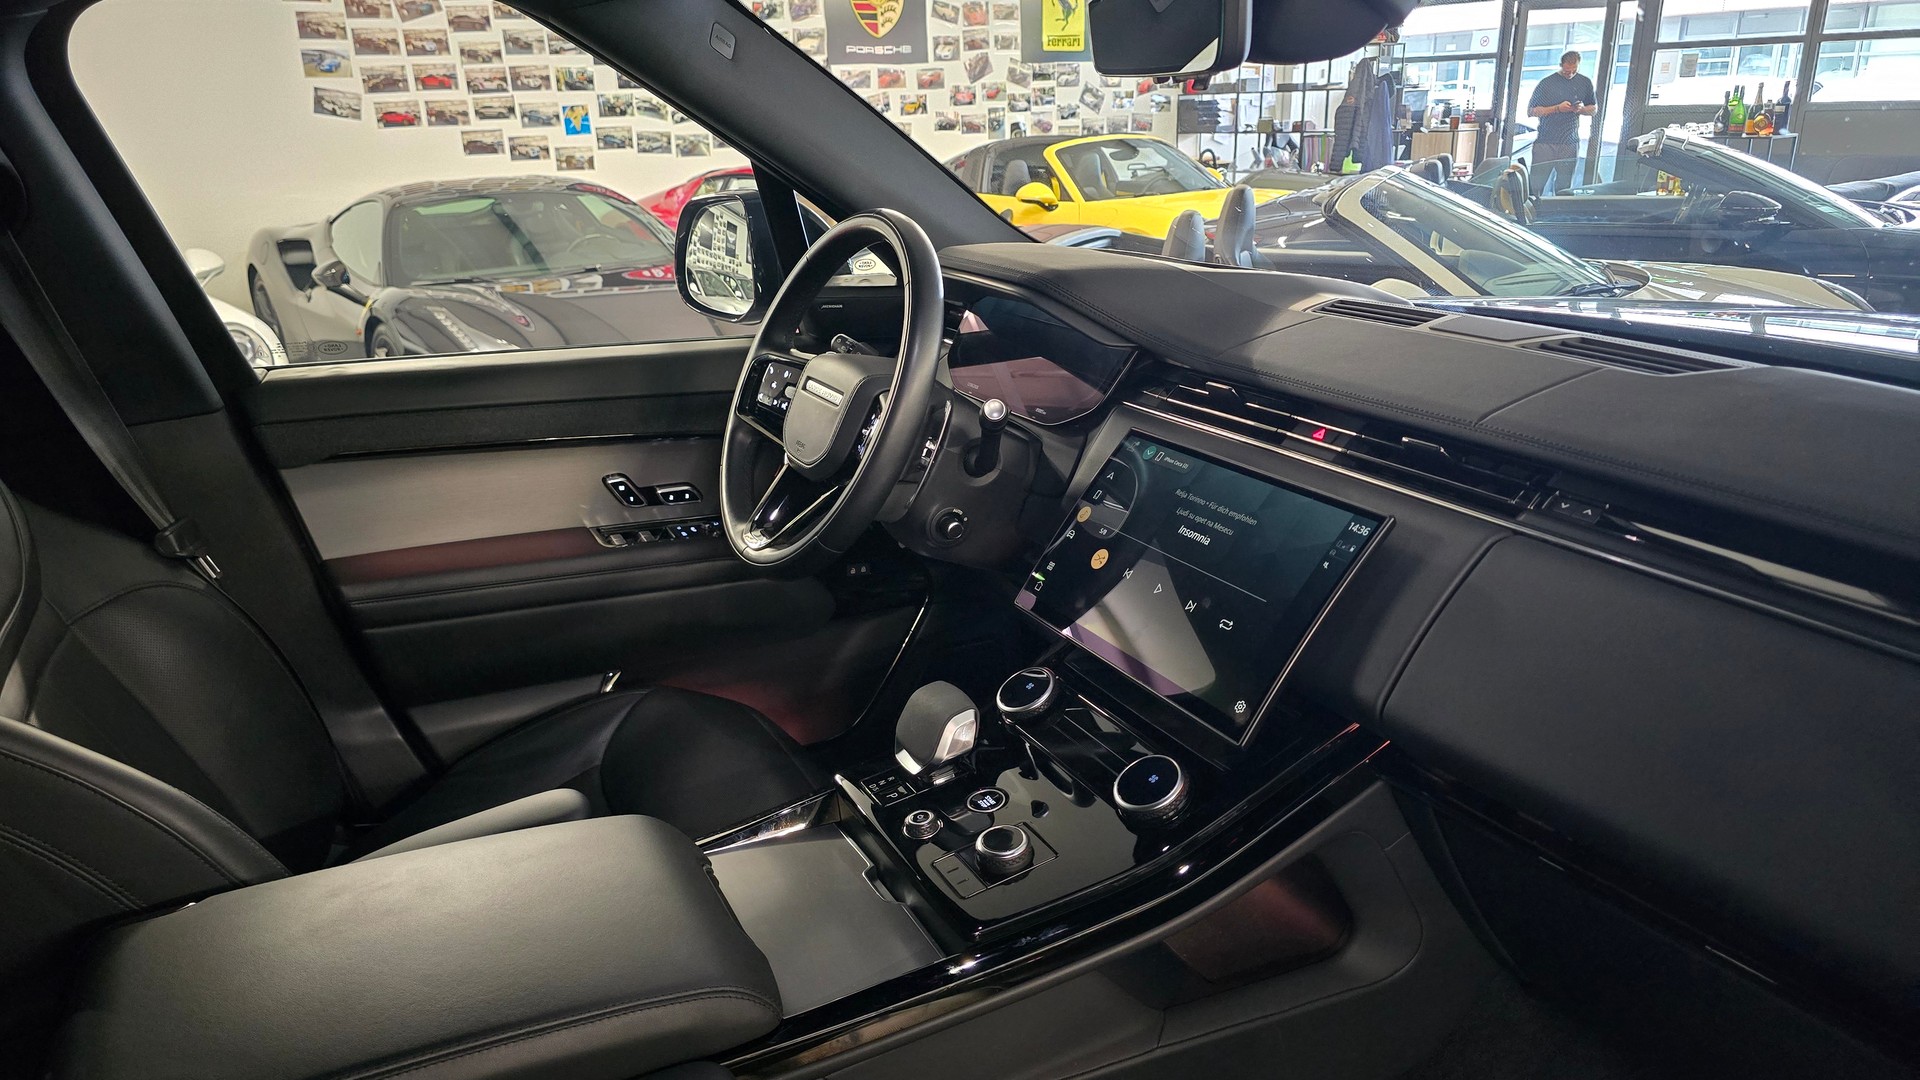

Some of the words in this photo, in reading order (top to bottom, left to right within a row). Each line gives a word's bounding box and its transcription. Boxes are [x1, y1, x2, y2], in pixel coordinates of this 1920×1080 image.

[846, 45, 912, 54] PORSCHE
[1047, 35, 1080, 47] Ferrari
[1208, 501, 1217, 510] Für
[1217, 505, 1229, 515] dich
[1228, 511, 1258, 526] empfohlen
[1194, 515, 1207, 525] opet
[1206, 520, 1214, 528] na
[1213, 522, 1234, 536] Mesecu
[1348, 521, 1371, 536] 14:36
[1177, 525, 1211, 546] Insomnia
